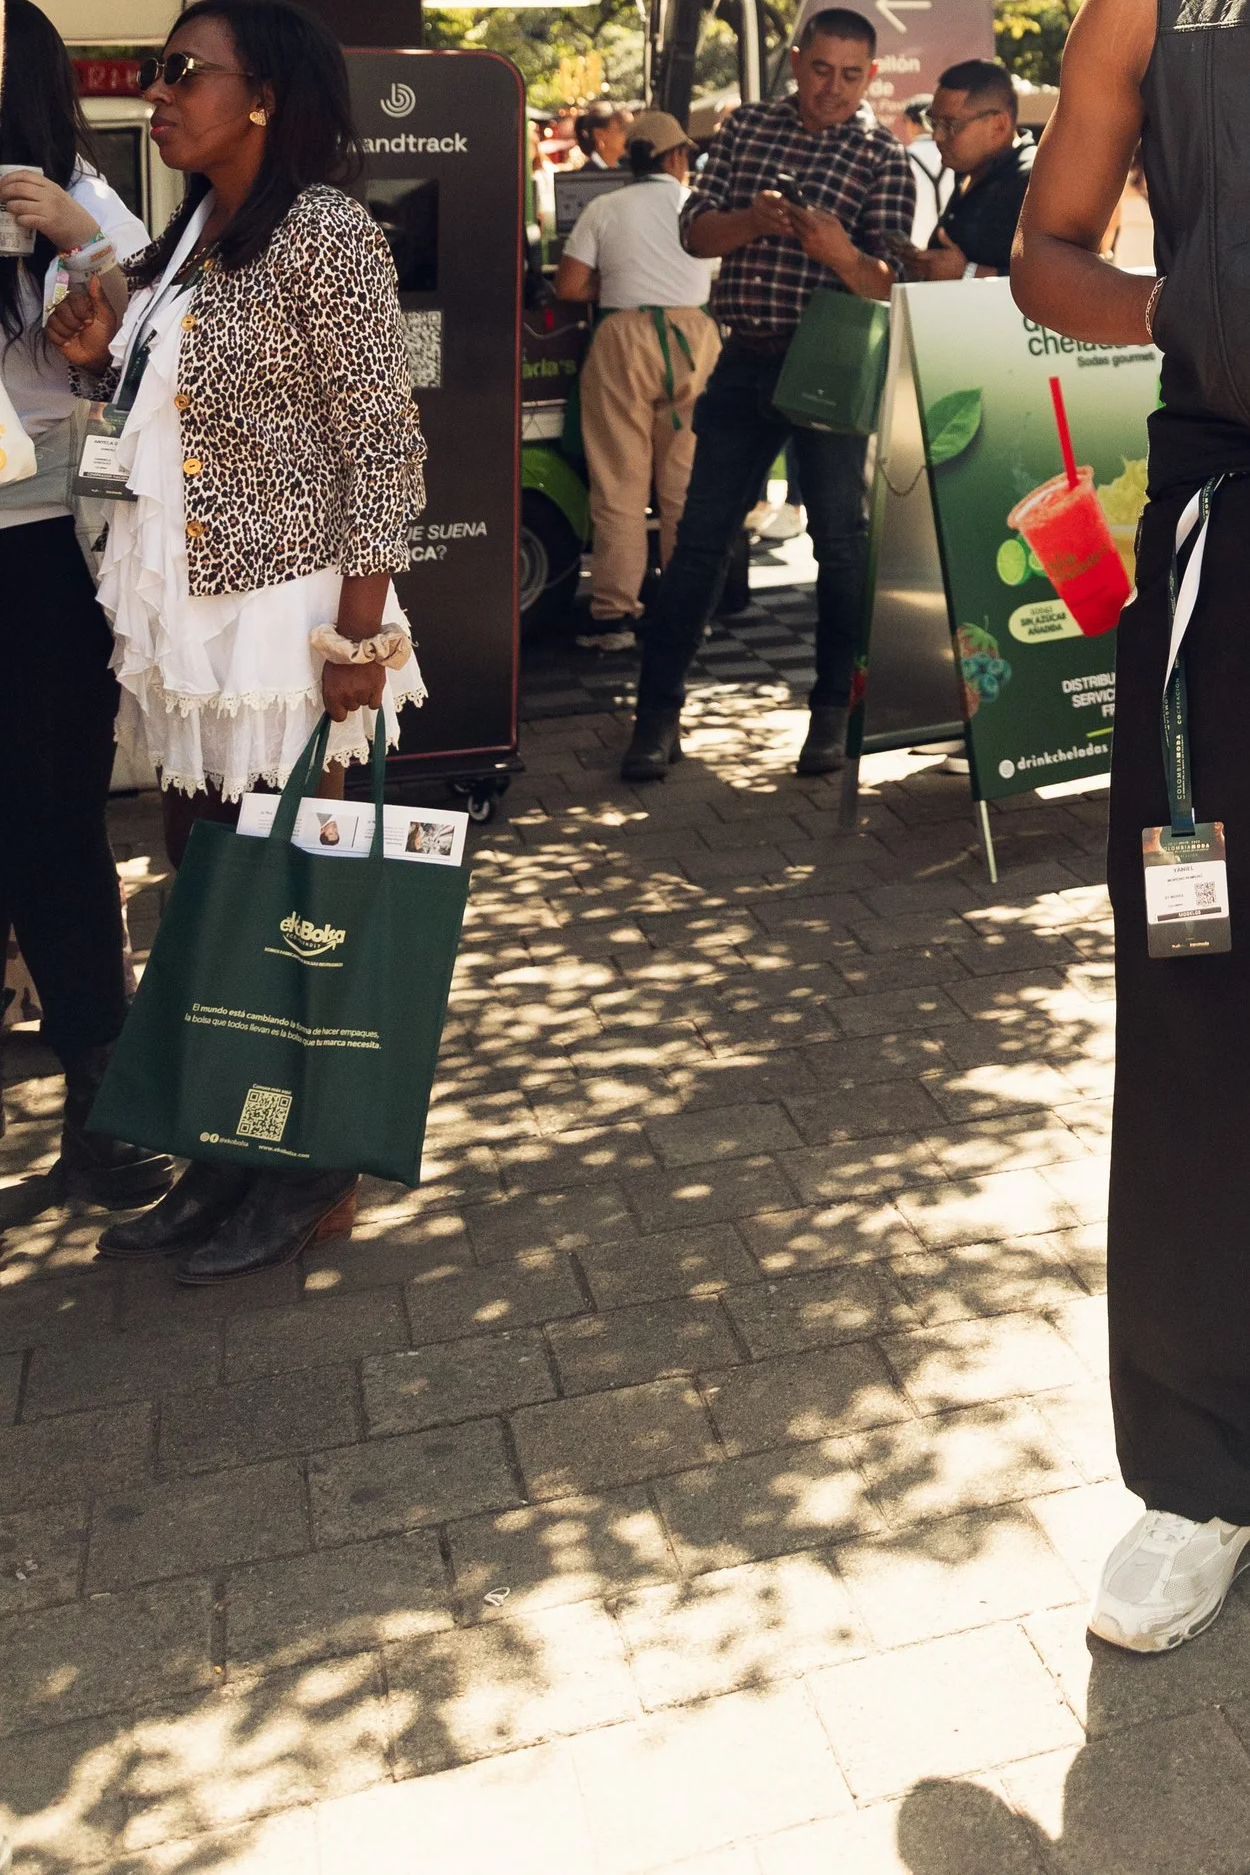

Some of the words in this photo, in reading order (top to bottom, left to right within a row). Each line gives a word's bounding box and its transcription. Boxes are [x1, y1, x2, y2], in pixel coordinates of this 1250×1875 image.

[347, 132, 469, 154] andtrack
[427, 521, 488, 541] SUENA
[1061, 672, 1116, 694] DISTRIBU
[1071, 688, 1116, 709] SERVIC
[184, 1012, 191, 1022] la
[192, 1014, 212, 1024] bolsa
[212, 1018, 227, 1028] que
[227, 1020, 249, 1031] todos
[249, 1023, 271, 1035] llevan
[271, 1029, 280, 1037] es
[280, 1029, 287, 1038] la
[302, 1036, 316, 1047] que
[323, 1039, 346, 1047] marca
[346, 1040, 382, 1050] necesita.
[192, 1003, 201, 1012] El
[201, 1005, 228, 1015] mundo
[229, 1008, 246, 1018] está
[246, 1011, 290, 1027] cambiando
[312, 1027, 322, 1036] de
[322, 1027, 339, 1036] hacer
[340, 1028, 380, 1039] empaques,
